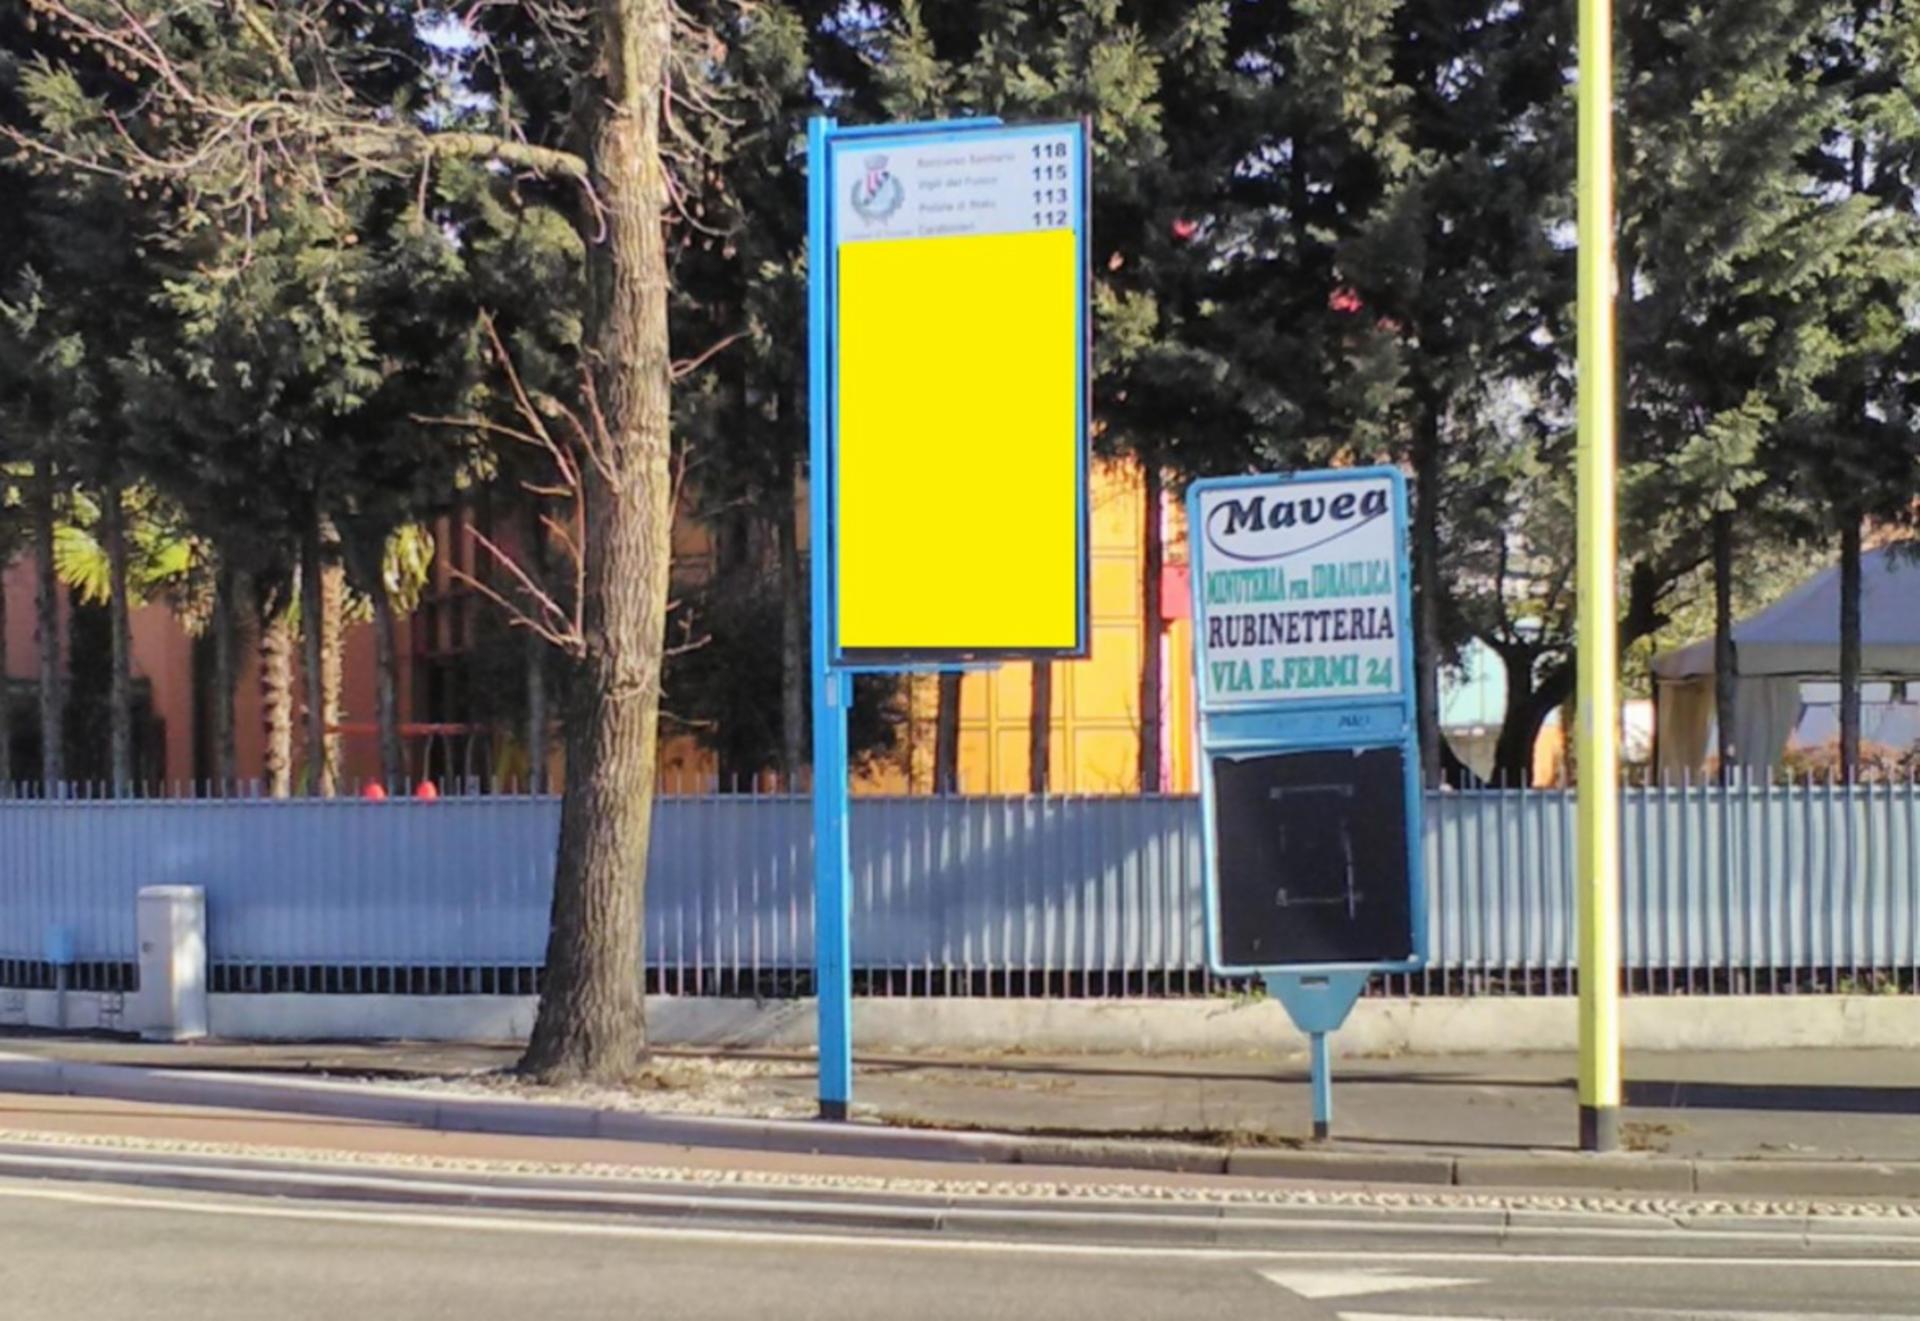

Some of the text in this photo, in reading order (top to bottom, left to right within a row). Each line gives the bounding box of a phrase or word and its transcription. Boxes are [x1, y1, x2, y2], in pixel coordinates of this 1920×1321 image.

[1032, 142, 1067, 159] 118
[1033, 165, 1067, 181] 115
[1033, 188, 1068, 205] 113
[1033, 211, 1068, 226] 112
[1223, 488, 1389, 536] Mavea
[1312, 560, 1391, 598] IDRAULICA
[1209, 606, 1395, 649] RUBINETTERIA
[1211, 654, 1393, 693] VIA E.FERMI 24
